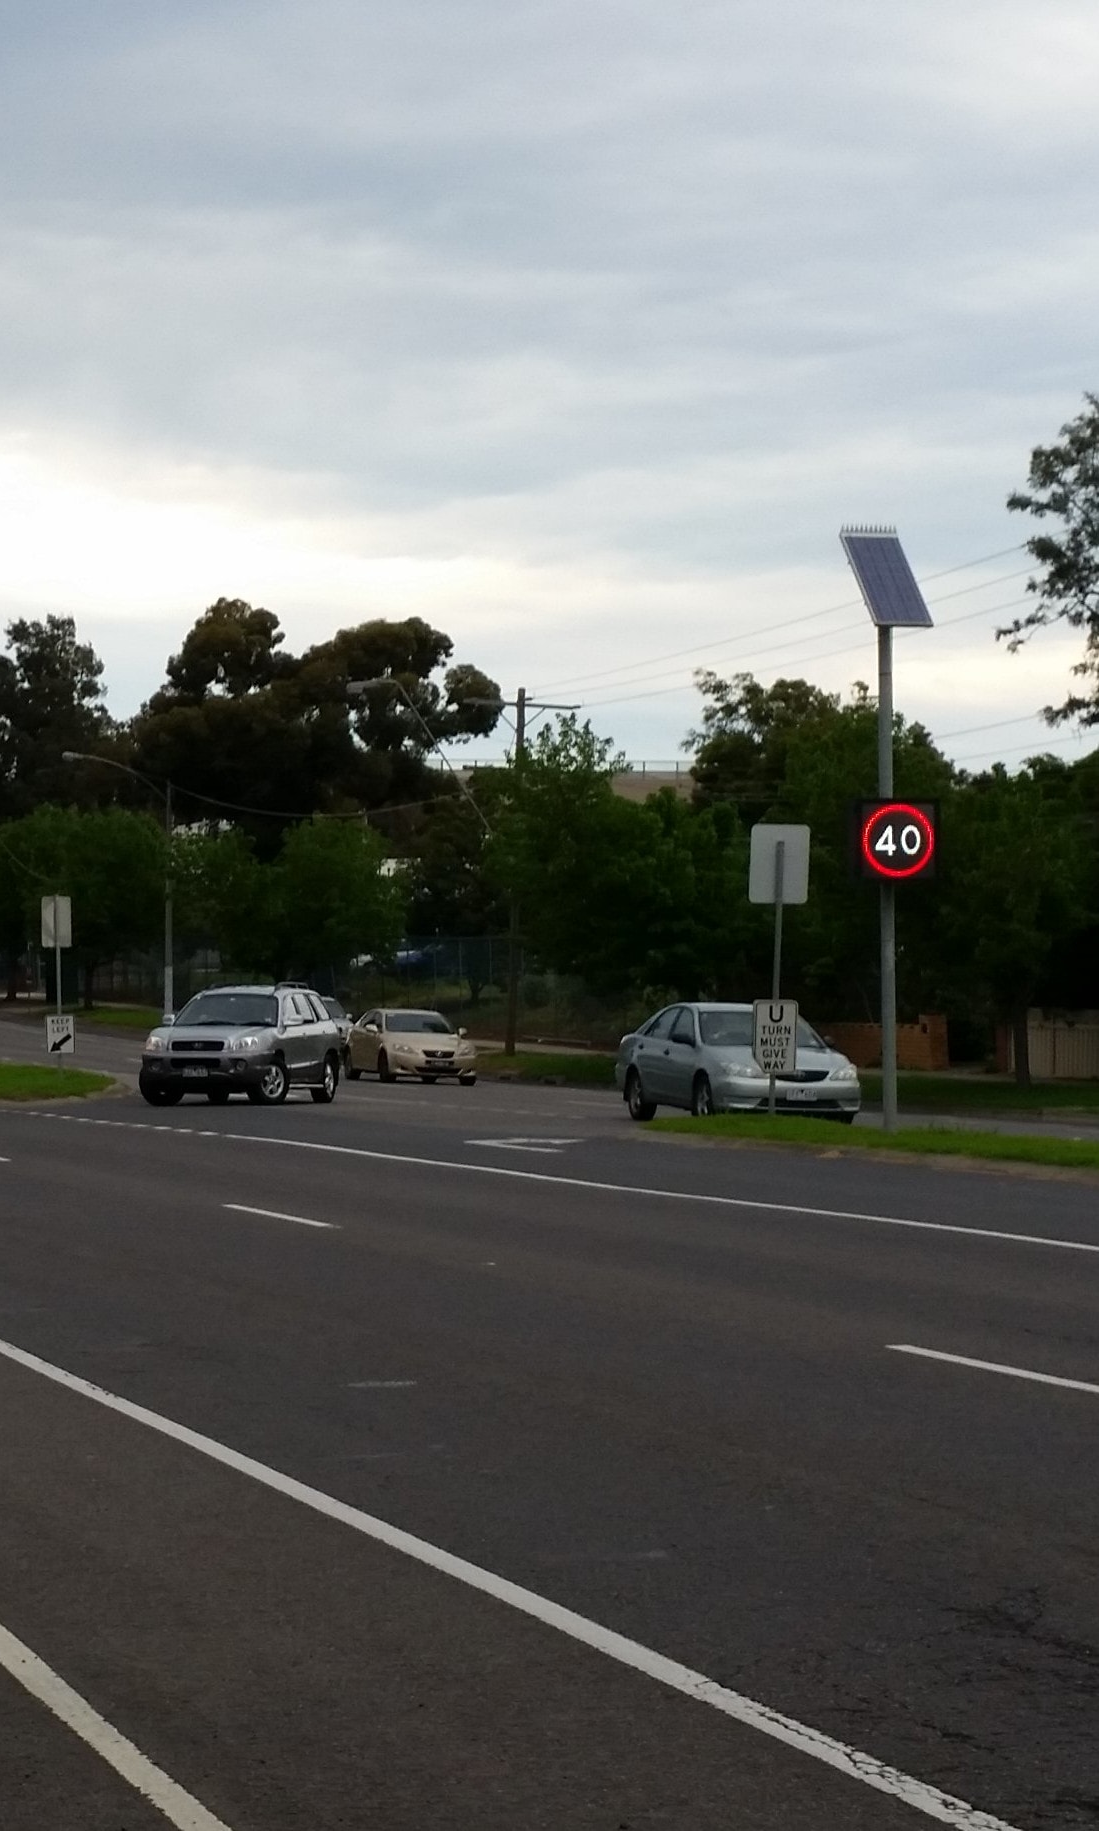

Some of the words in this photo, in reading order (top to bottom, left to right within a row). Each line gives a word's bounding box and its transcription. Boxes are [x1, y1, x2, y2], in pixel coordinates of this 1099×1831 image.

[874, 824, 921, 856] 40
[769, 1005, 784, 1023] U
[50, 1017, 70, 1025] KEEP
[51, 1025, 69, 1034] LEFT
[761, 1025, 791, 1035] TURN
[760, 1037, 790, 1047] MUST
[762, 1049, 787, 1058] GIVE
[763, 1060, 786, 1070] WAY
